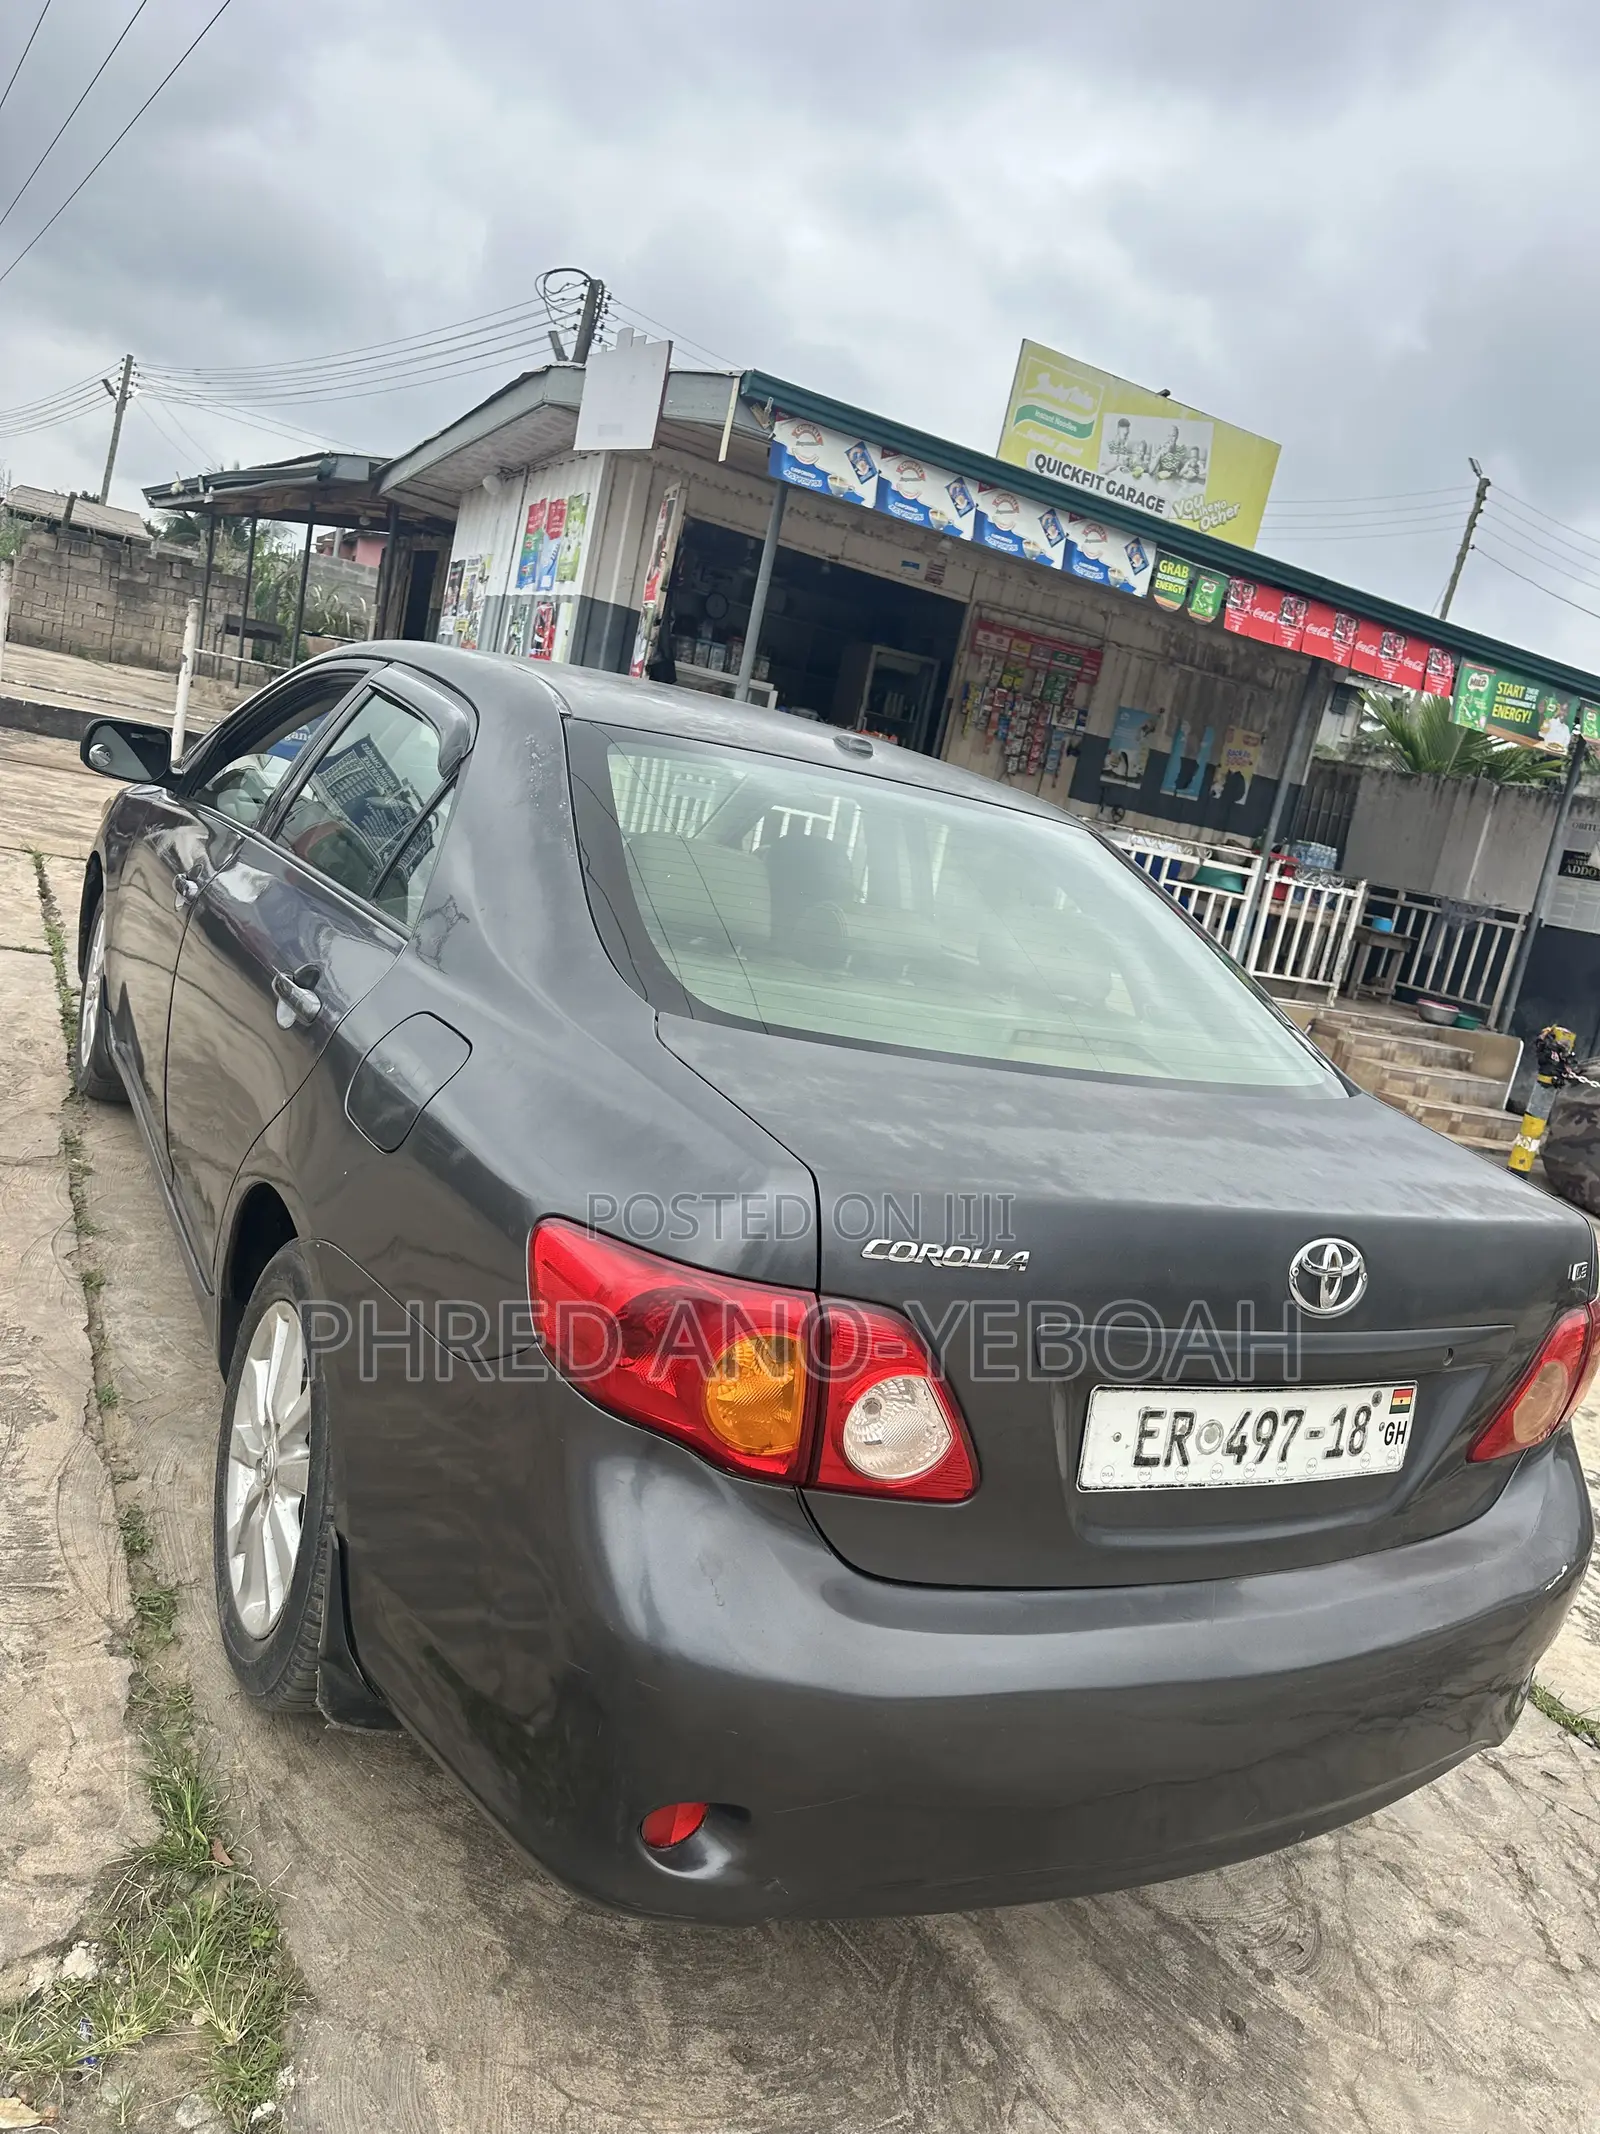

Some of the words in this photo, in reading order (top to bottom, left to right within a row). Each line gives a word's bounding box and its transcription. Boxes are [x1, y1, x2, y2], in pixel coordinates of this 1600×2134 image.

[1034, 453, 1105, 491] QUICKFIT
[1105, 480, 1165, 514] GARAGE
[1159, 560, 1189, 578] GRAB
[1155, 580, 1186, 595] ENERGY!
[1469, 677, 1487, 688] MILO
[1496, 681, 1525, 698] START
[1492, 703, 1532, 724] ENERGY!
[1571, 822, 1600, 832] OBITU
[1564, 864, 1598, 877] ADDO
[860, 1239, 1031, 1271] COROLLA
[1383, 1421, 1408, 1446] GH
